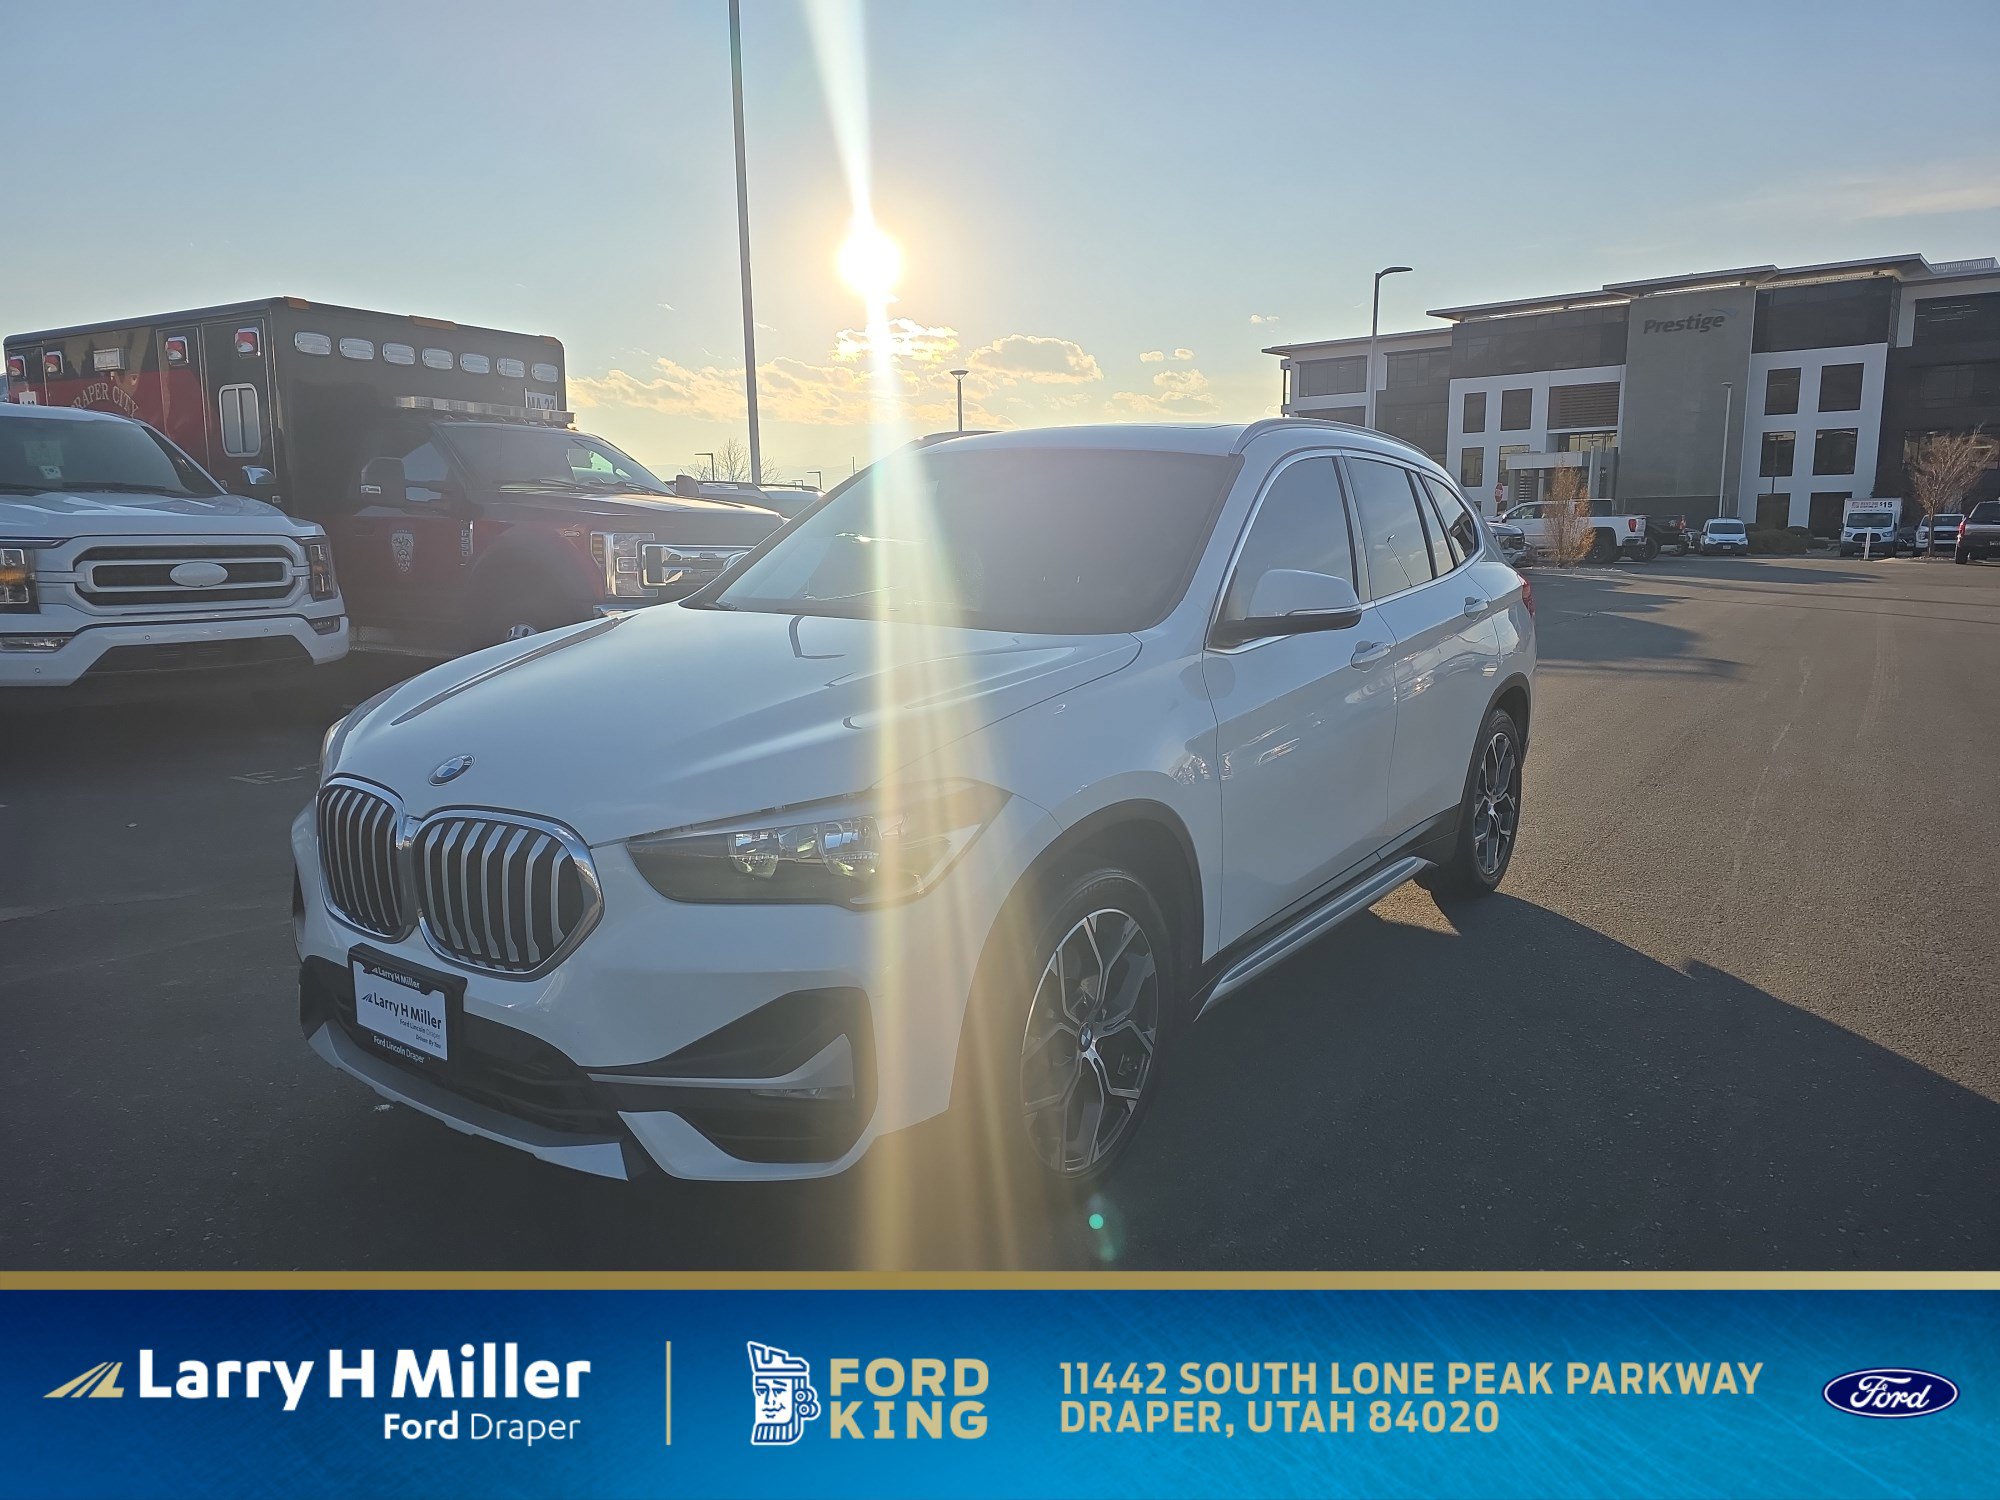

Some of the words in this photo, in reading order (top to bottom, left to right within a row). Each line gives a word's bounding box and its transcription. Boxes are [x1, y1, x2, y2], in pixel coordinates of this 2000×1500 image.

[1643, 313, 1725, 334] Prestige
[112, 385, 139, 419] CITY
[378, 966, 395, 982] Larry
[400, 975, 420, 989] Miller
[374, 992, 399, 1017] Larry
[400, 1002, 409, 1018] H
[410, 1006, 442, 1030] Miller
[399, 1018, 410, 1028] Ford
[373, 1035, 386, 1048] Ford
[386, 1040, 406, 1056] Lincoln
[405, 1048, 425, 1064] Draper
